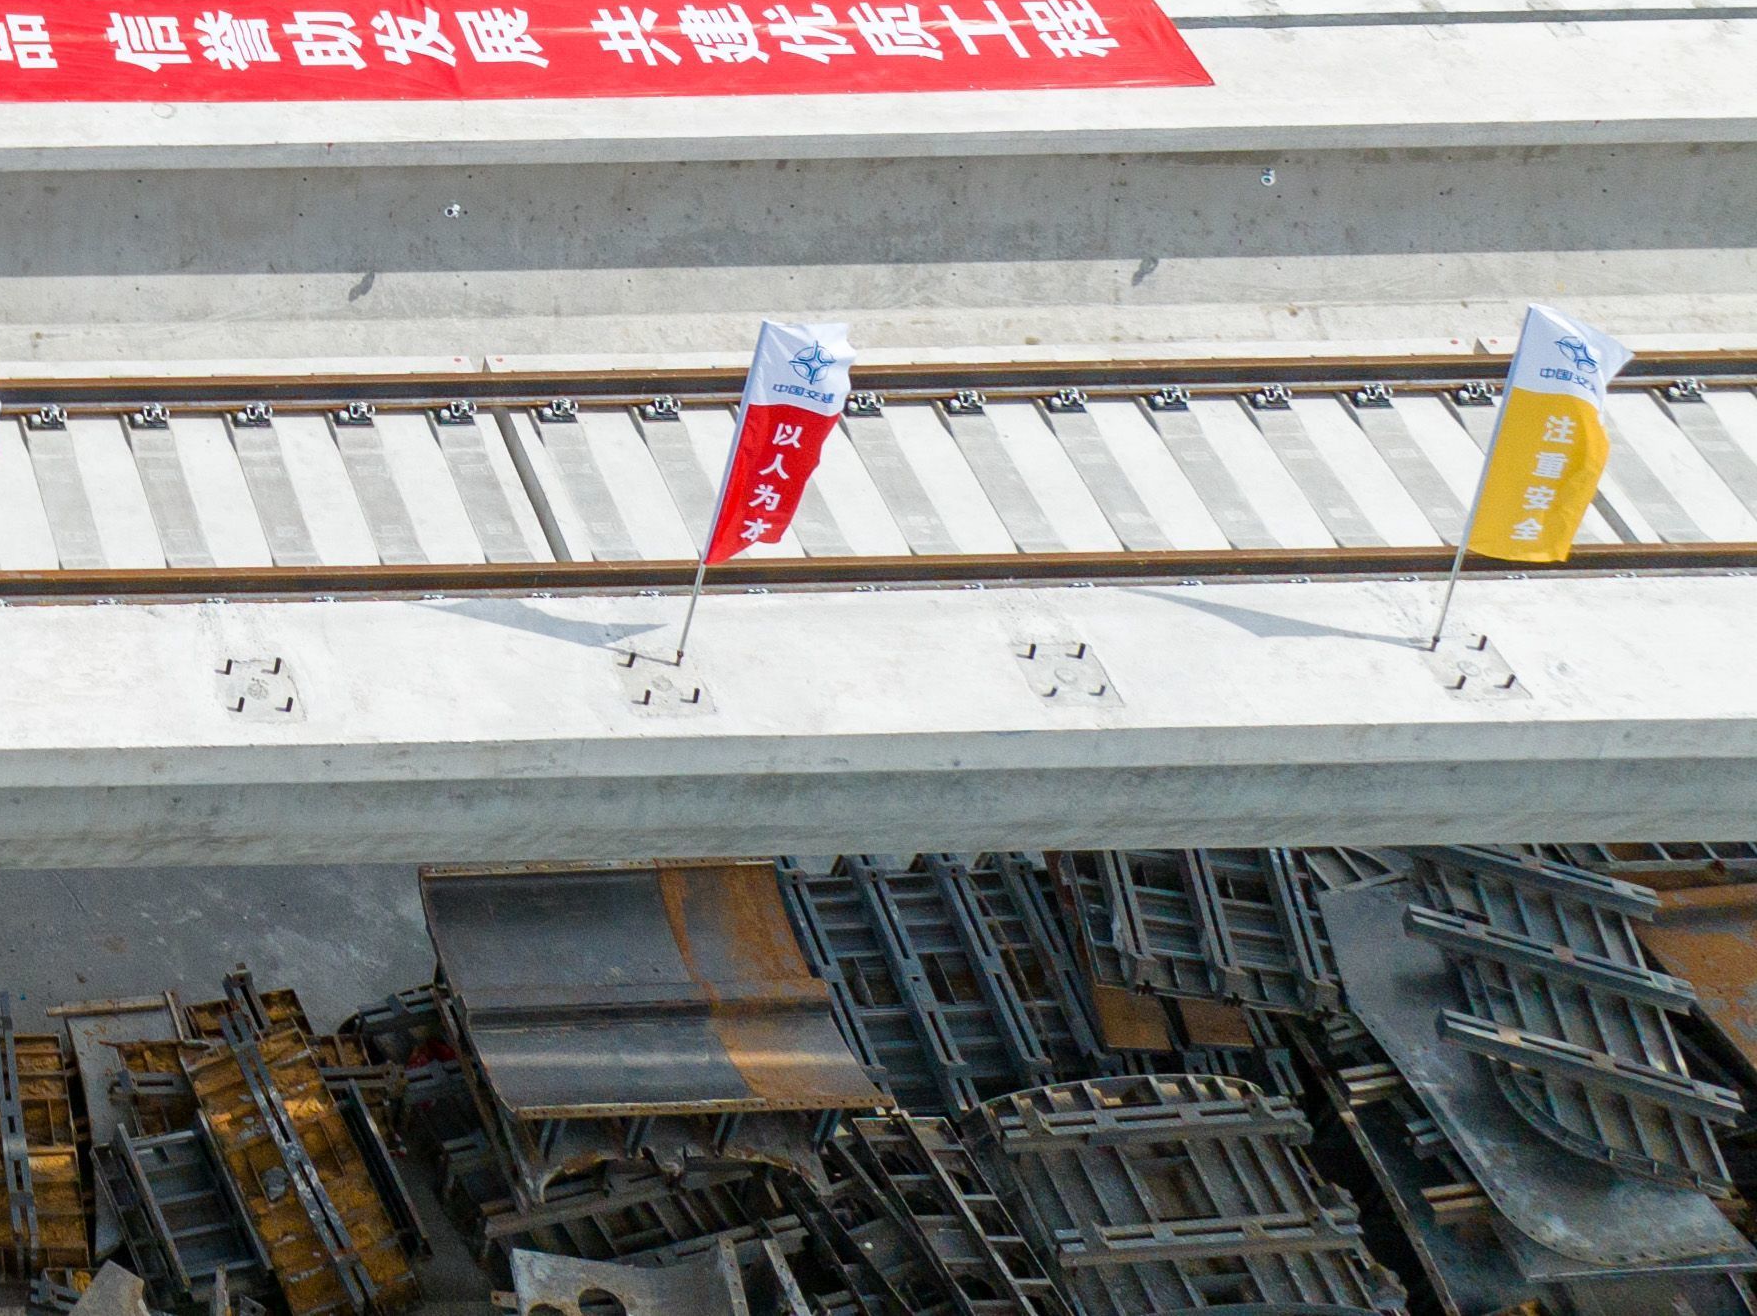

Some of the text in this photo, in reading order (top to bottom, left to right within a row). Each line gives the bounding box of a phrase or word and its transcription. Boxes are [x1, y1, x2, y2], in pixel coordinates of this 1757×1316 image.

[100, 5, 550, 73] 信誉助发展
[772, 383, 835, 404] 中国交建
[739, 422, 803, 543] 以人为本
[1509, 415, 1577, 542] 注重安全
